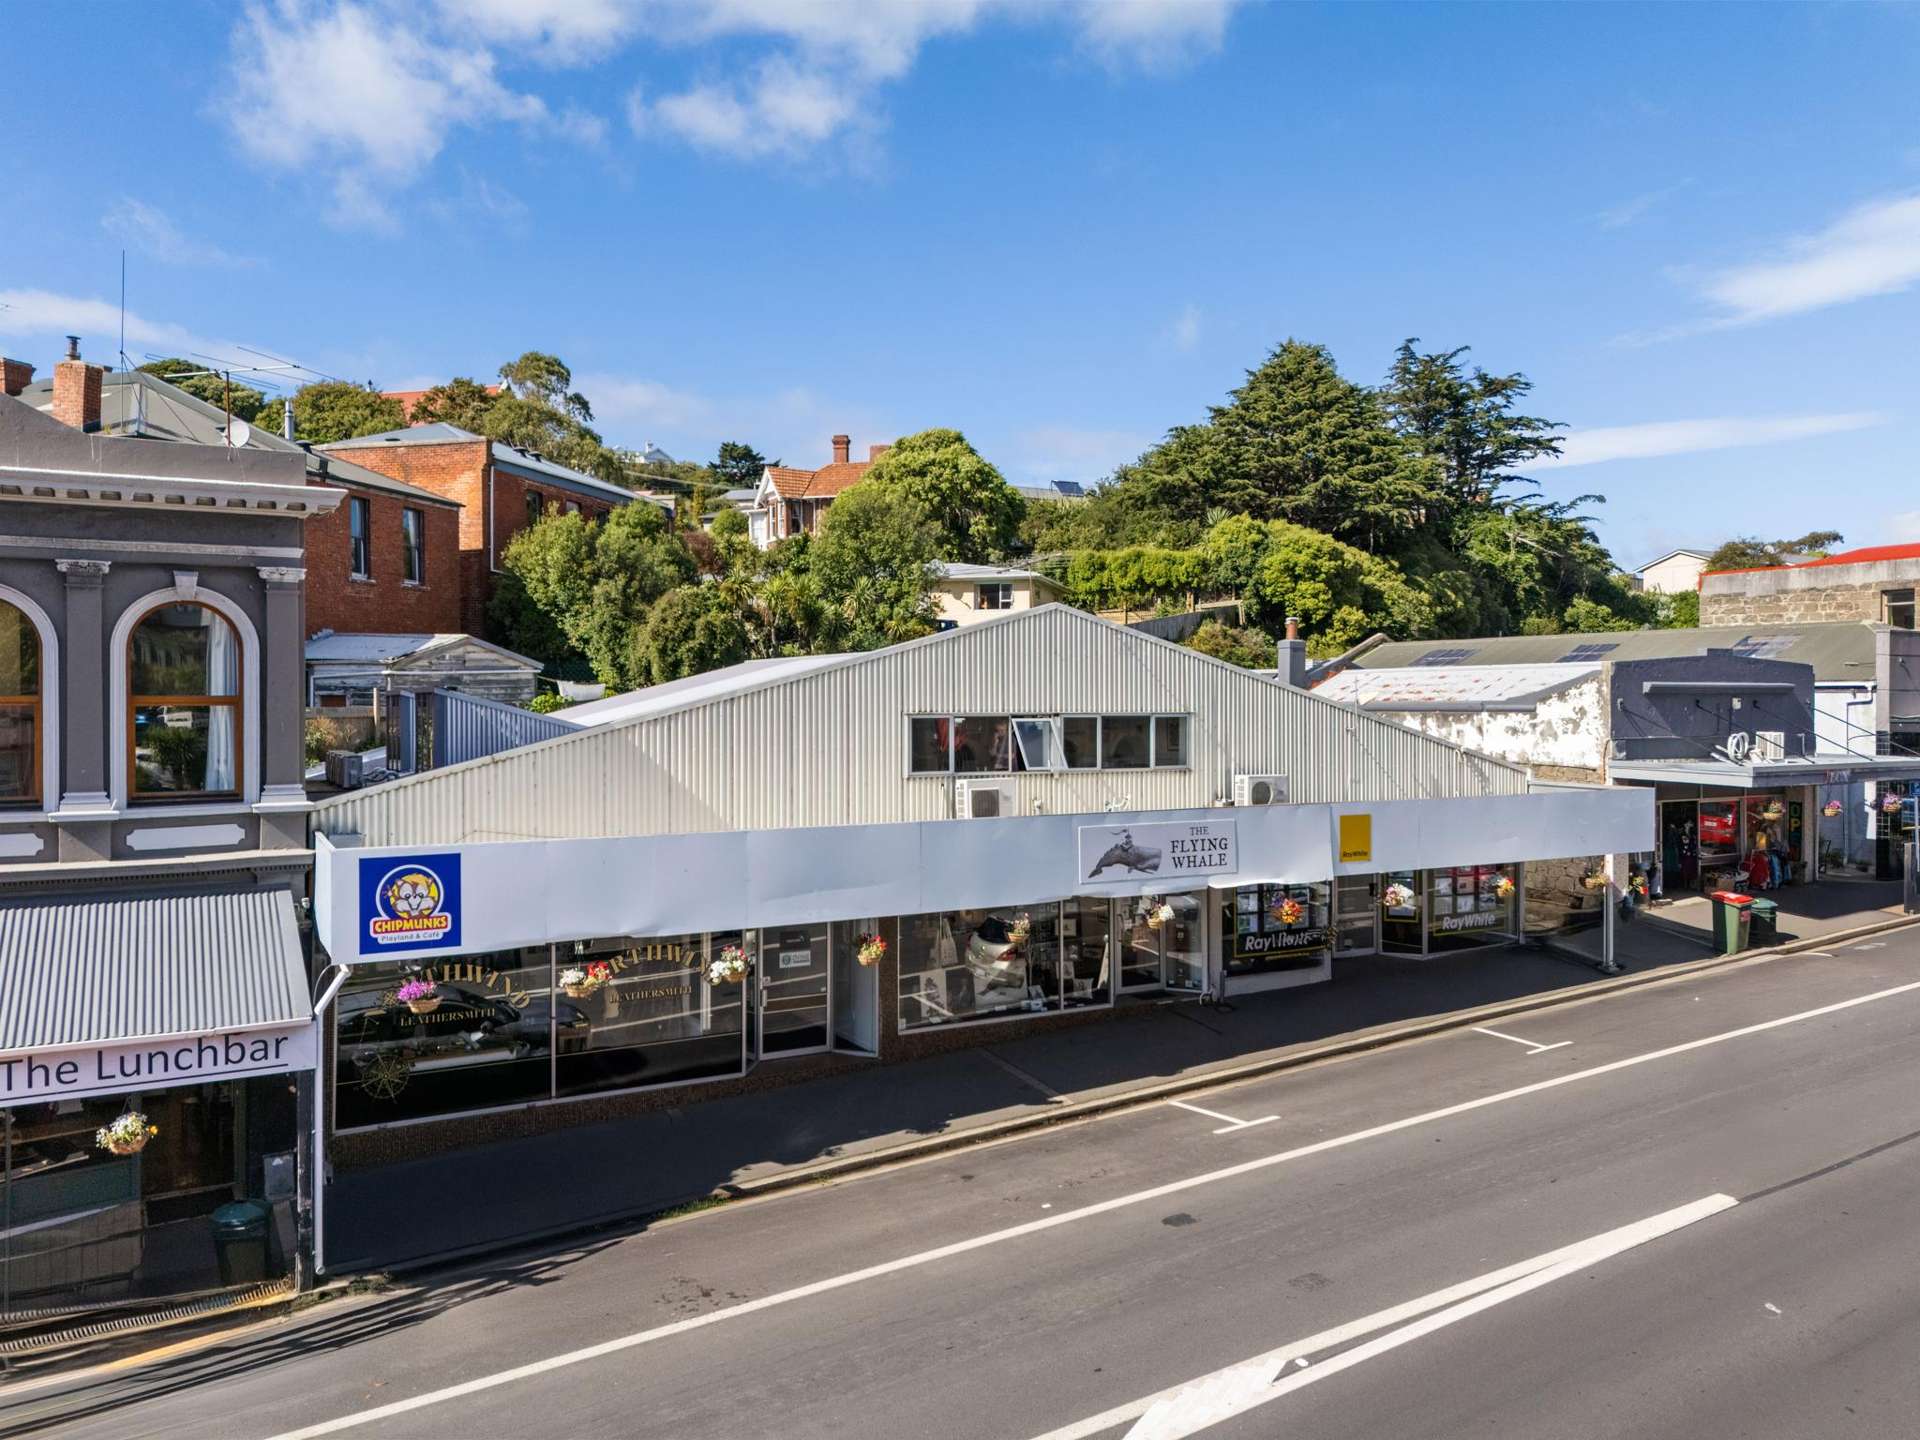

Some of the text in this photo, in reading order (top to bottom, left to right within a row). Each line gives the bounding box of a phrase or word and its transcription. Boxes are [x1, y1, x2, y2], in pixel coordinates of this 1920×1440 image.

[1189, 826, 1209, 836] THE
[1170, 837, 1228, 853] FLYING
[1171, 853, 1227, 869] WHALE
[374, 916, 446, 933] CHIPMUNKS
[1442, 913, 1496, 931] RayWhite
[381, 931, 413, 943] Playland
[415, 931, 421, 940] &
[400, 1008, 496, 1027] LEATHERSMITH
[0, 1033, 289, 1091] The Lunchbar
